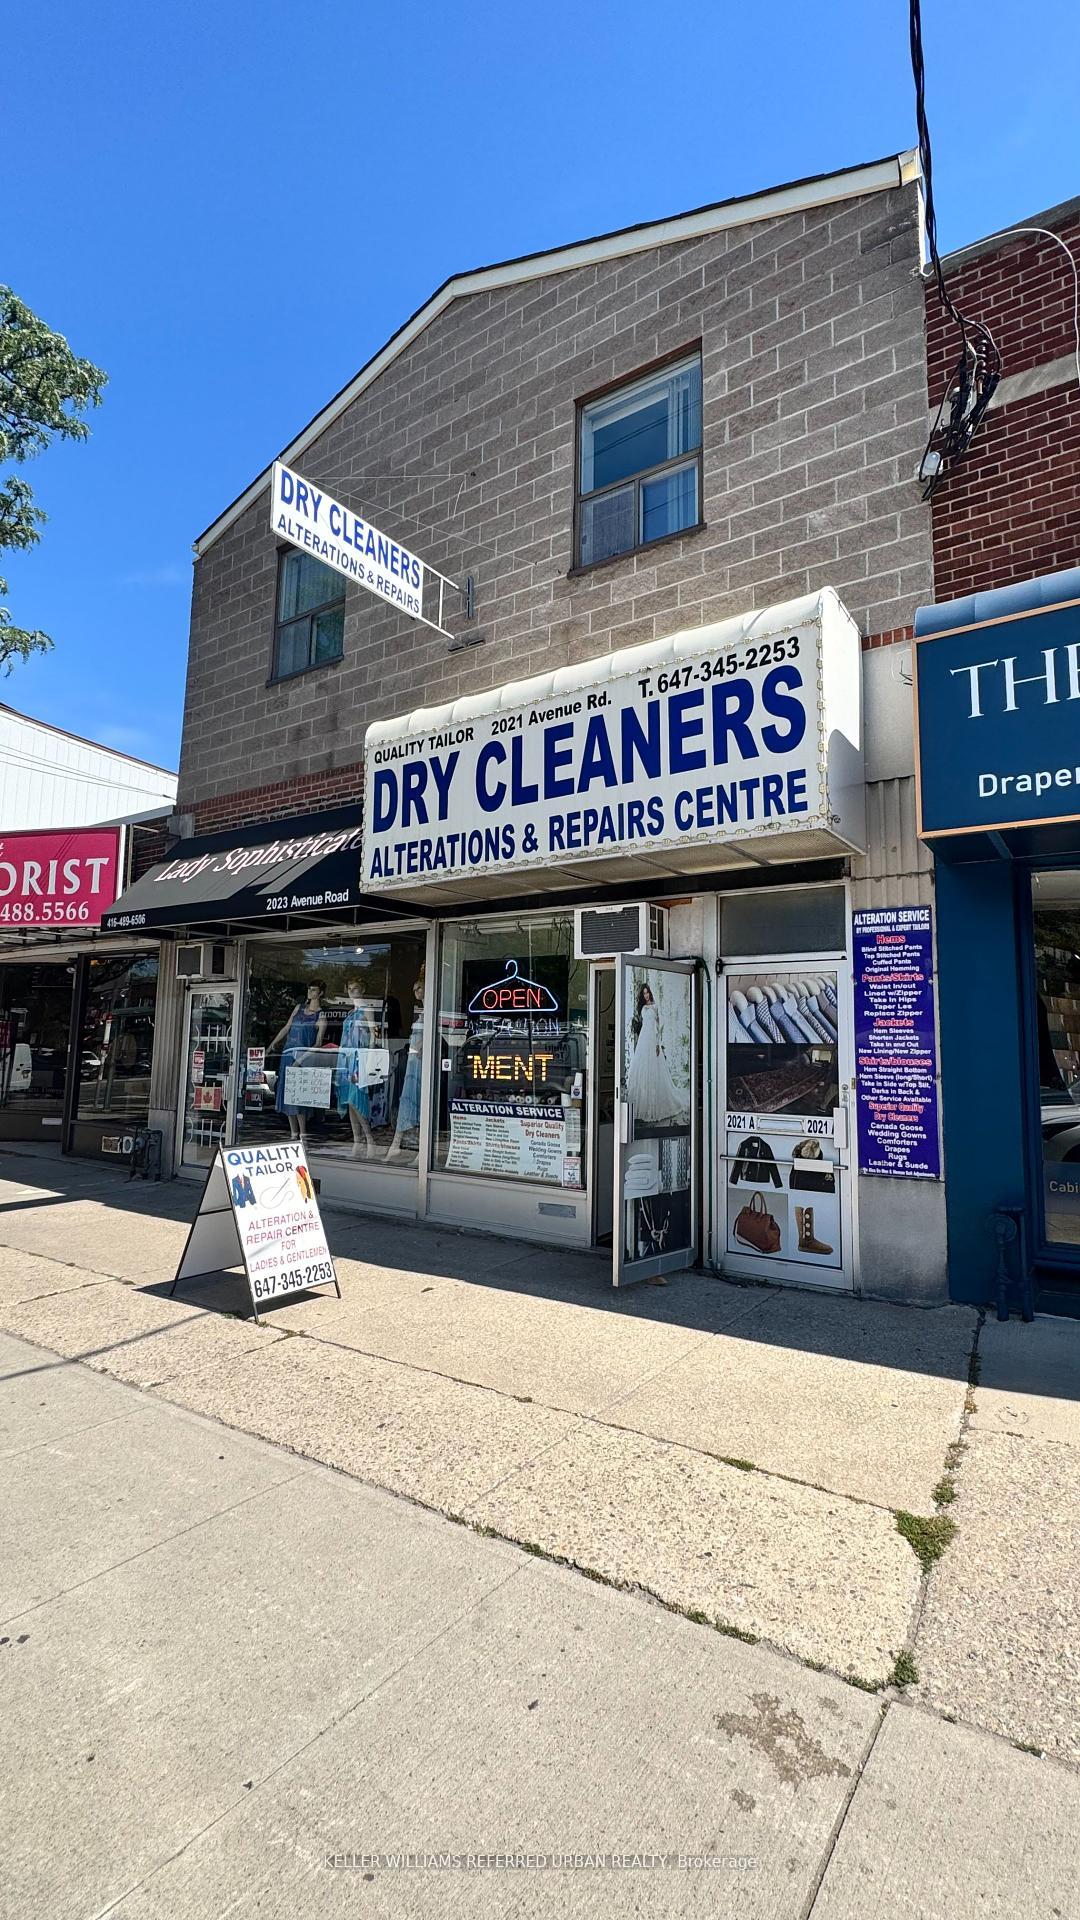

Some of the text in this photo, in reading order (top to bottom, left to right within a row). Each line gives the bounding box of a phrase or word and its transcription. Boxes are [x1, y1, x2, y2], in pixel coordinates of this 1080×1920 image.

[280, 469, 420, 589] DRY CLEANERS
[278, 514, 420, 614] ALTERATIONS & REPAIRS
[374, 636, 801, 764] QUALITY TAILOR 2021 Avenue Rd. T. 647-345-2253
[372, 665, 807, 834] DRY CLEANERS
[369, 769, 808, 880] ALTERATIONS & REPAIRS CENTRE
[153, 853, 218, 883] Lady
[0, 857, 110, 897] ORIST
[266, 888, 349, 910] 2023 Avenue Road
[0, 900, 89, 921] 488.5566
[854, 910, 929, 925] ALTERATION SERVICE
[862, 925, 891, 933] PROFESSIONAL
[876, 934, 905, 944] Hems
[483, 988, 541, 1009] OPEN
[873, 1017, 914, 1026] Jackets
[249, 1049, 264, 1057] BUY
[451, 1102, 562, 1118] ALTERATION SERVICE
[868, 1101, 924, 1113] Superior Quality
[727, 1115, 755, 1129] 2021 A
[874, 1111, 886, 1122] Dry
[520, 1120, 564, 1131] Superior Quality
[807, 1120, 828, 1134] 2021
[870, 1122, 897, 1130] Canada
[525, 1129, 560, 1139] Dry Cleaners
[867, 1129, 927, 1139] Wedding Gowns
[877, 1137, 918, 1146] Comforters
[227, 1146, 300, 1166] QUALITY
[885, 1145, 910, 1153] Drapes
[868, 1158, 895, 1167] Leather
[888, 1153, 907, 1161] Rugs
[246, 1162, 294, 1176] TAILOR
[248, 1210, 314, 1231] ALTERATION &
[246, 1222, 320, 1245] REPAIR CENTRE
[282, 1240, 296, 1251] FOR
[250, 1246, 327, 1272] LADIES & GENTLEMEN
[254, 1262, 332, 1298] 647-345-2253
